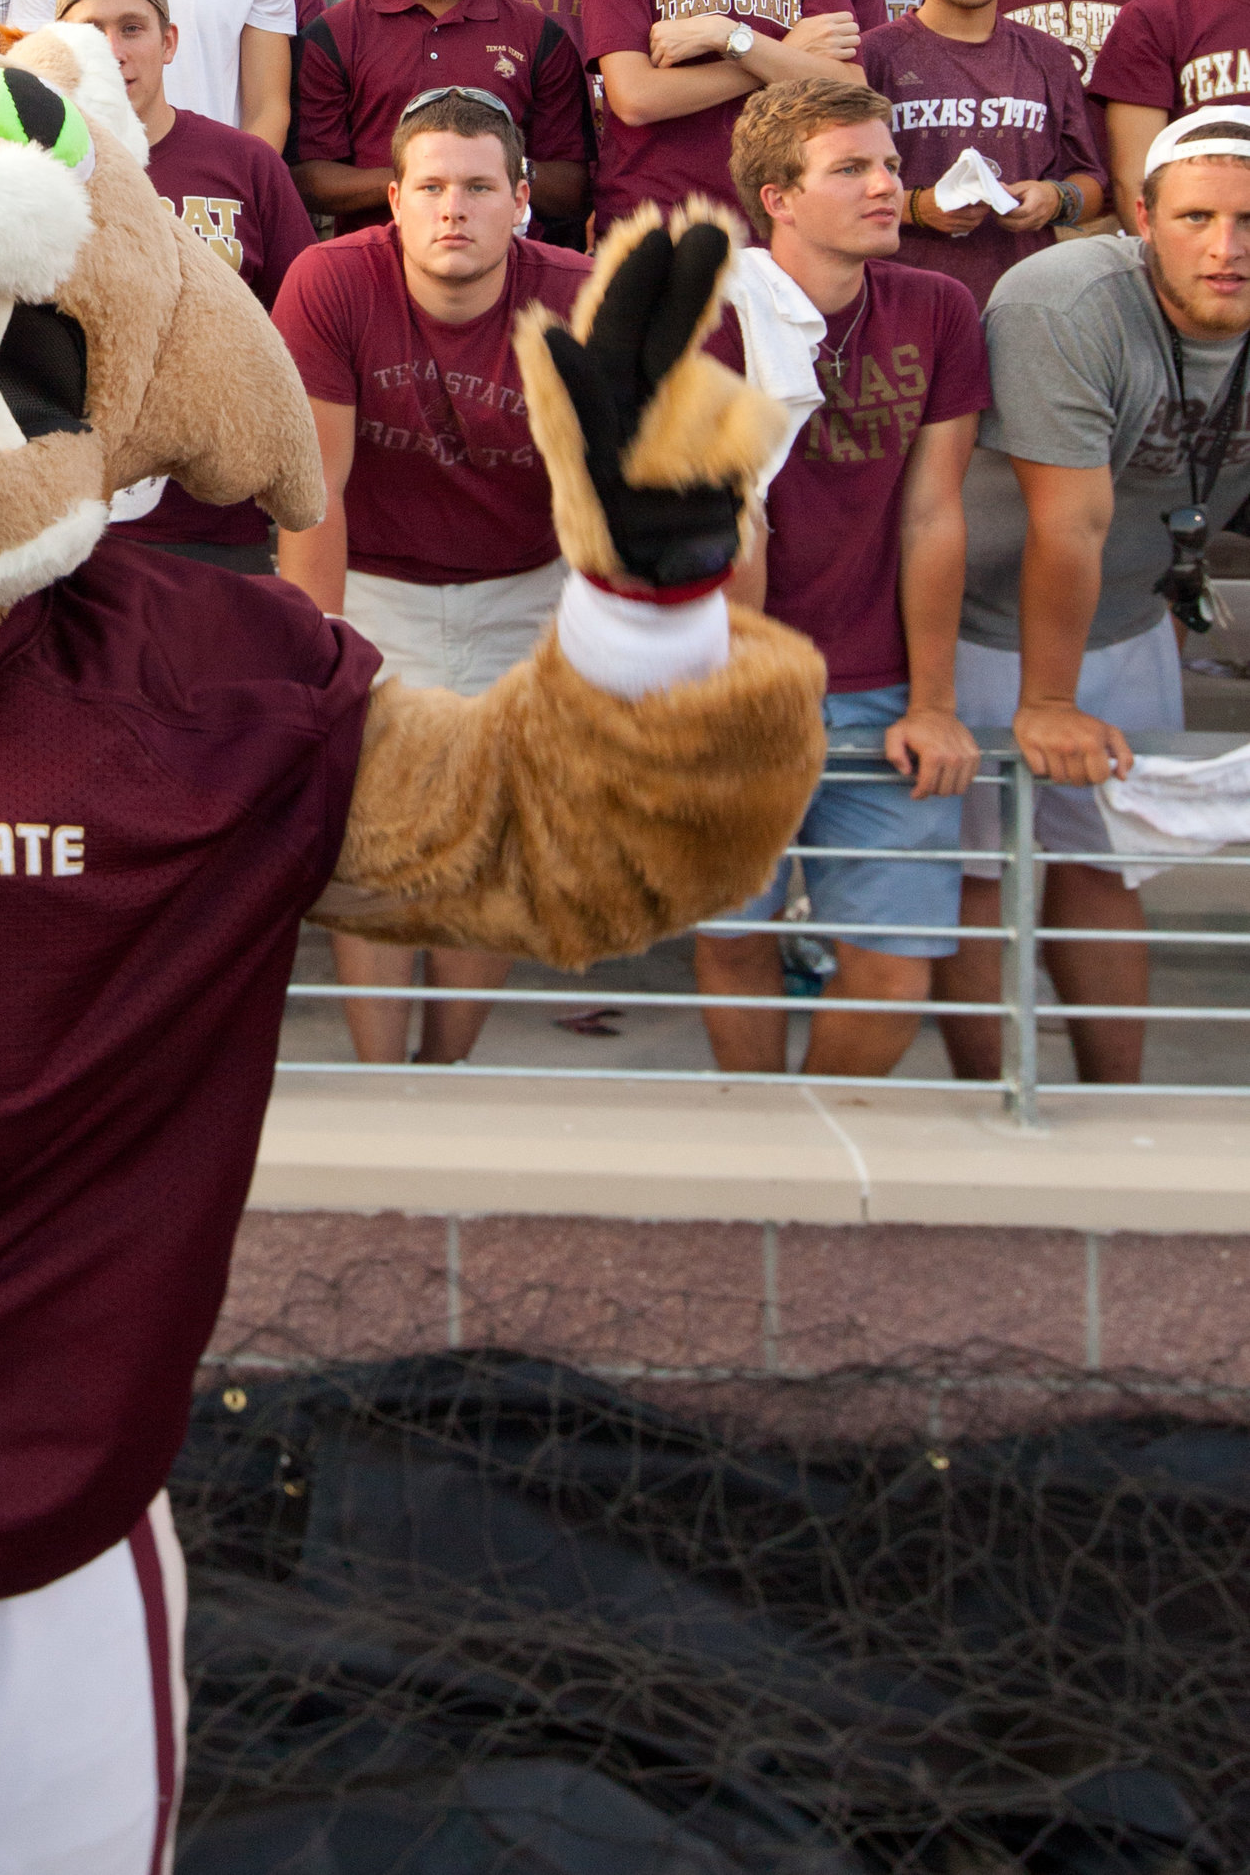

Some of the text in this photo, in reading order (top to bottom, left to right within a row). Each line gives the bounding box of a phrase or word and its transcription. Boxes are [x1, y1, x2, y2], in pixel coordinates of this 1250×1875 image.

[508, 46, 526, 61] STATE
[1180, 48, 1250, 108] TEXA
[891, 96, 1047, 133] TEXAS STATE
[921, 129, 1031, 139] BOBCAS
[810, 343, 928, 409] XAS
[804, 400, 923, 462] TATE
